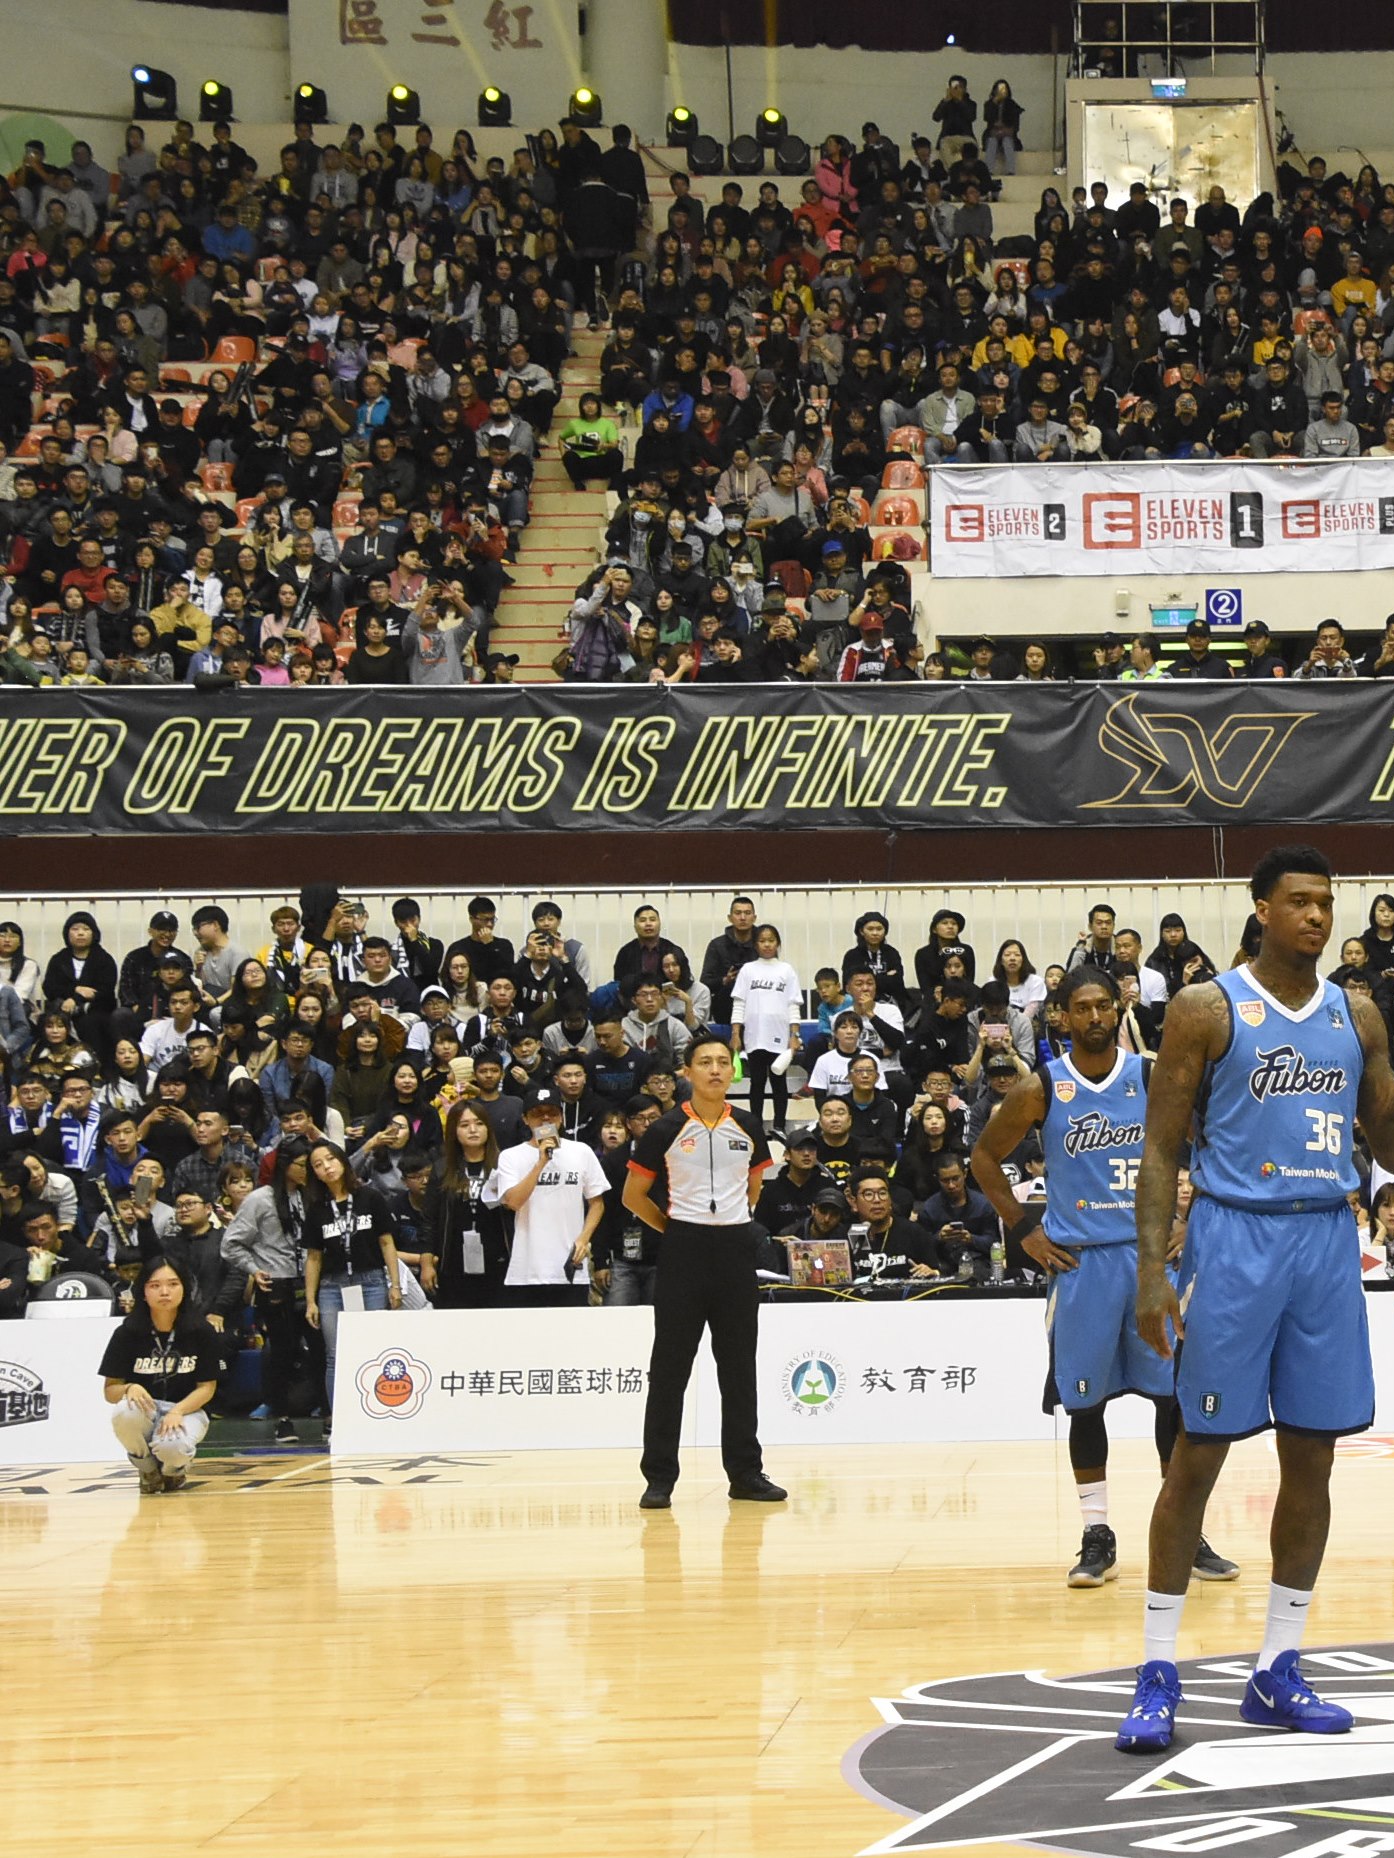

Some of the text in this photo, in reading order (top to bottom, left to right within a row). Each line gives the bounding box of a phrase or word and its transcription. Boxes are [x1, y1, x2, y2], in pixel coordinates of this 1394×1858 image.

[988, 508, 1039, 523] ELEVEN
[1147, 499, 1224, 520] ELEVEN
[1324, 502, 1374, 518] ELEVEN
[1386, 504, 1394, 527] PLUS
[988, 522, 1039, 537] SPORTS
[1049, 513, 1061, 533] 2
[1147, 521, 1224, 540] SPORTS
[1237, 505, 1256, 538] 1
[1325, 516, 1375, 532] SPORTS
[123, 716, 252, 814] OF
[234, 715, 582, 813] DREAMS
[572, 714, 677, 812] IS
[667, 712, 1013, 811] INFINITE.
[1250, 1045, 1347, 1103] Fubon
[1064, 1111, 1145, 1158] Fubon
[1306, 1109, 1344, 1155] 36
[1280, 1166, 1314, 1178] Taiwan
[1090, 1201, 1117, 1209] Taiwan
[10, 1368, 34, 1387] Cave
[441, 1367, 650, 1397] 中華民國籃球協
[860, 1366, 977, 1394] 教育部
[1080, 1380, 1086, 1393] B
[1205, 1395, 1215, 1412] B
